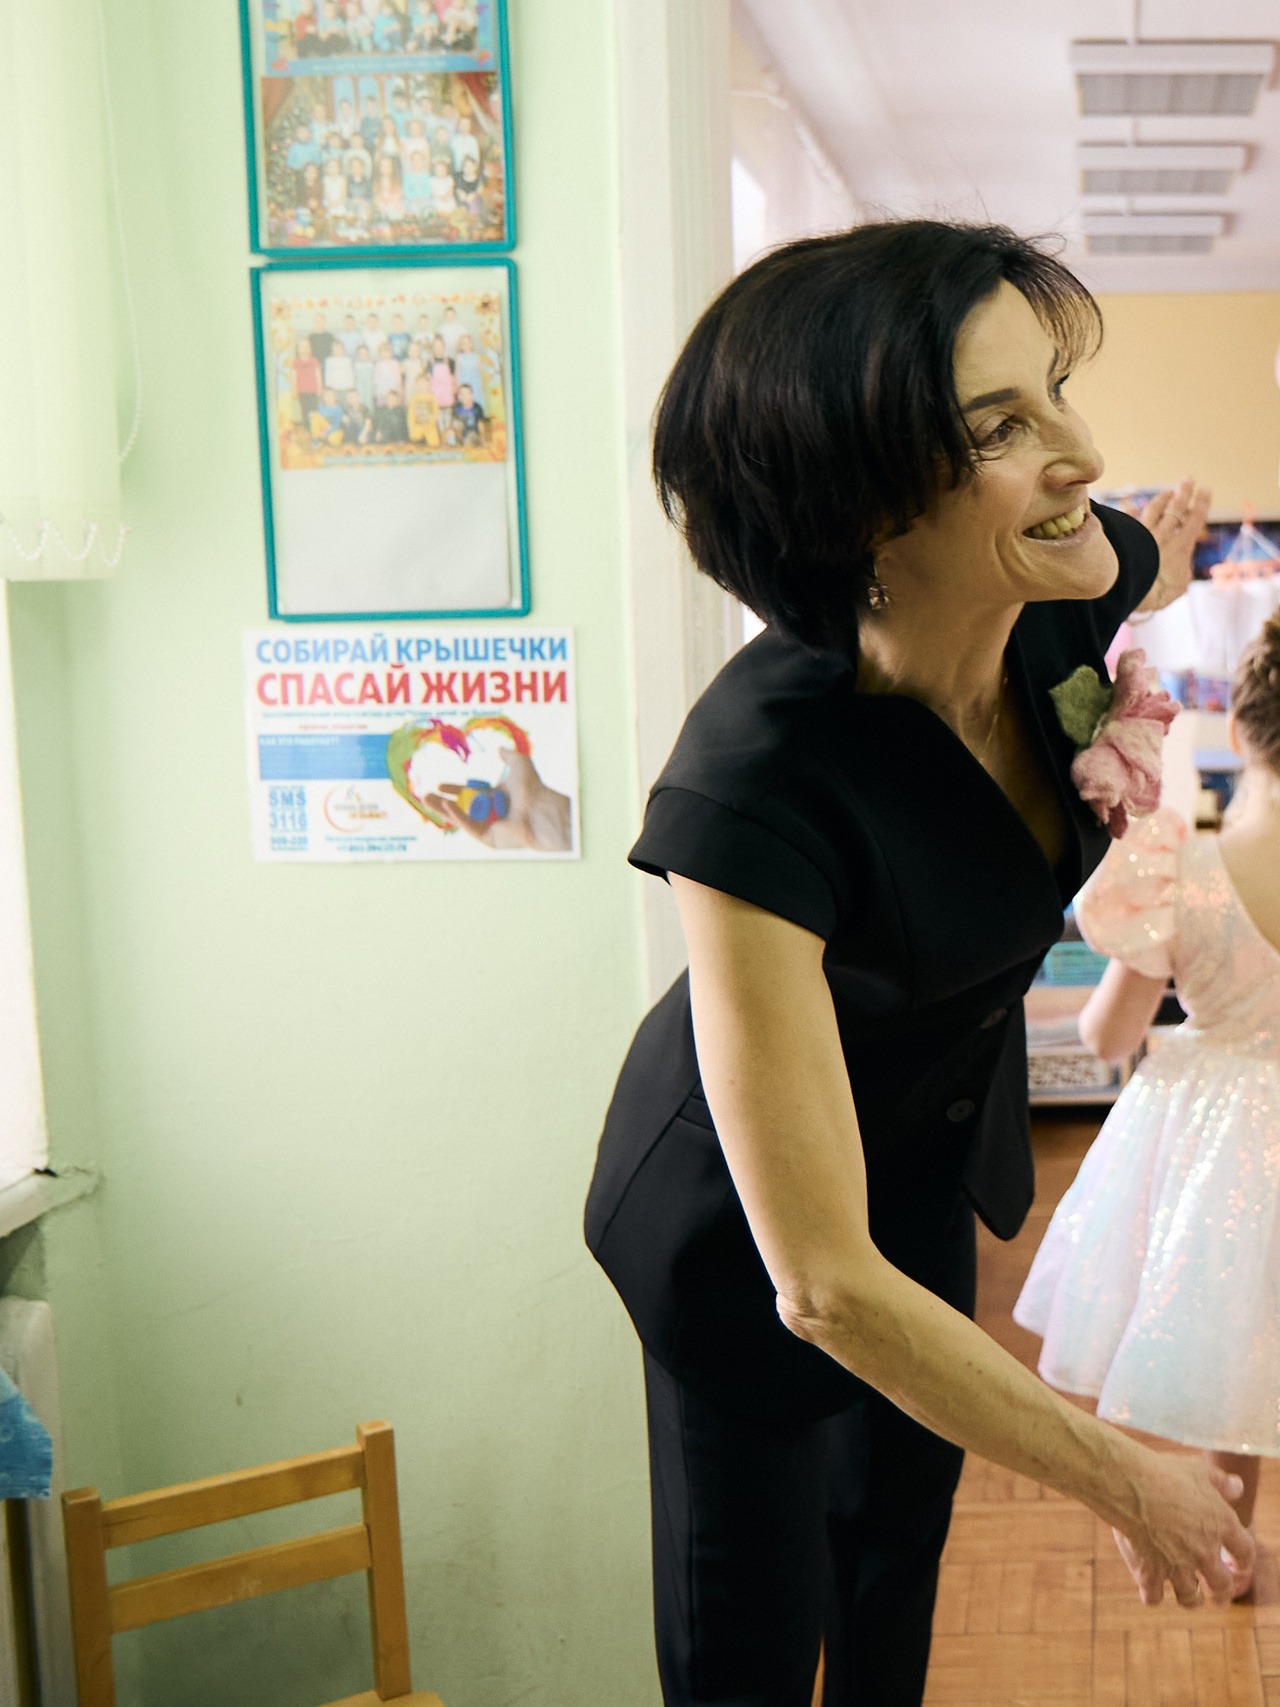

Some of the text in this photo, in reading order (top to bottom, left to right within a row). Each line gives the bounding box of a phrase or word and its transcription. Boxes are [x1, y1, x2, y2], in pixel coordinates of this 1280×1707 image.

[256, 633, 568, 662] СОБИРАЙ КРЫШЕЧКИ
[256, 663, 568, 705] СПАСАЙ ЖИЗНИ
[268, 791, 306, 806] SMS
